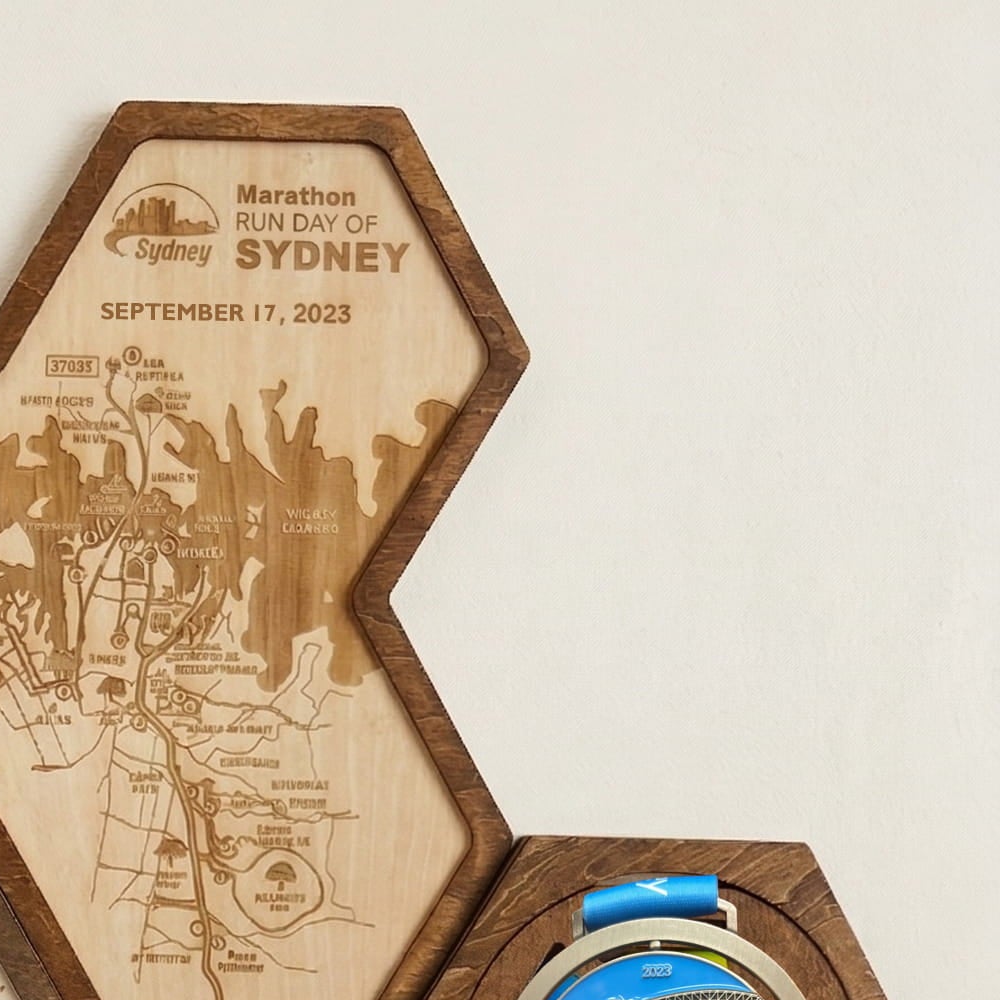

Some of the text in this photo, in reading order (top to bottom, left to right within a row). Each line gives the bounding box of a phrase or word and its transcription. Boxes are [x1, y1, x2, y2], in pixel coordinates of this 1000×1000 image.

[236, 184, 355, 206] Marathon
[236, 212, 378, 234] RUN DAY OF
[135, 237, 212, 267] Sydney
[235, 239, 410, 273] SYDNEY
[101, 302, 351, 326] SEPTEMBER 17, 2023
[642, 963, 673, 979] 2023
